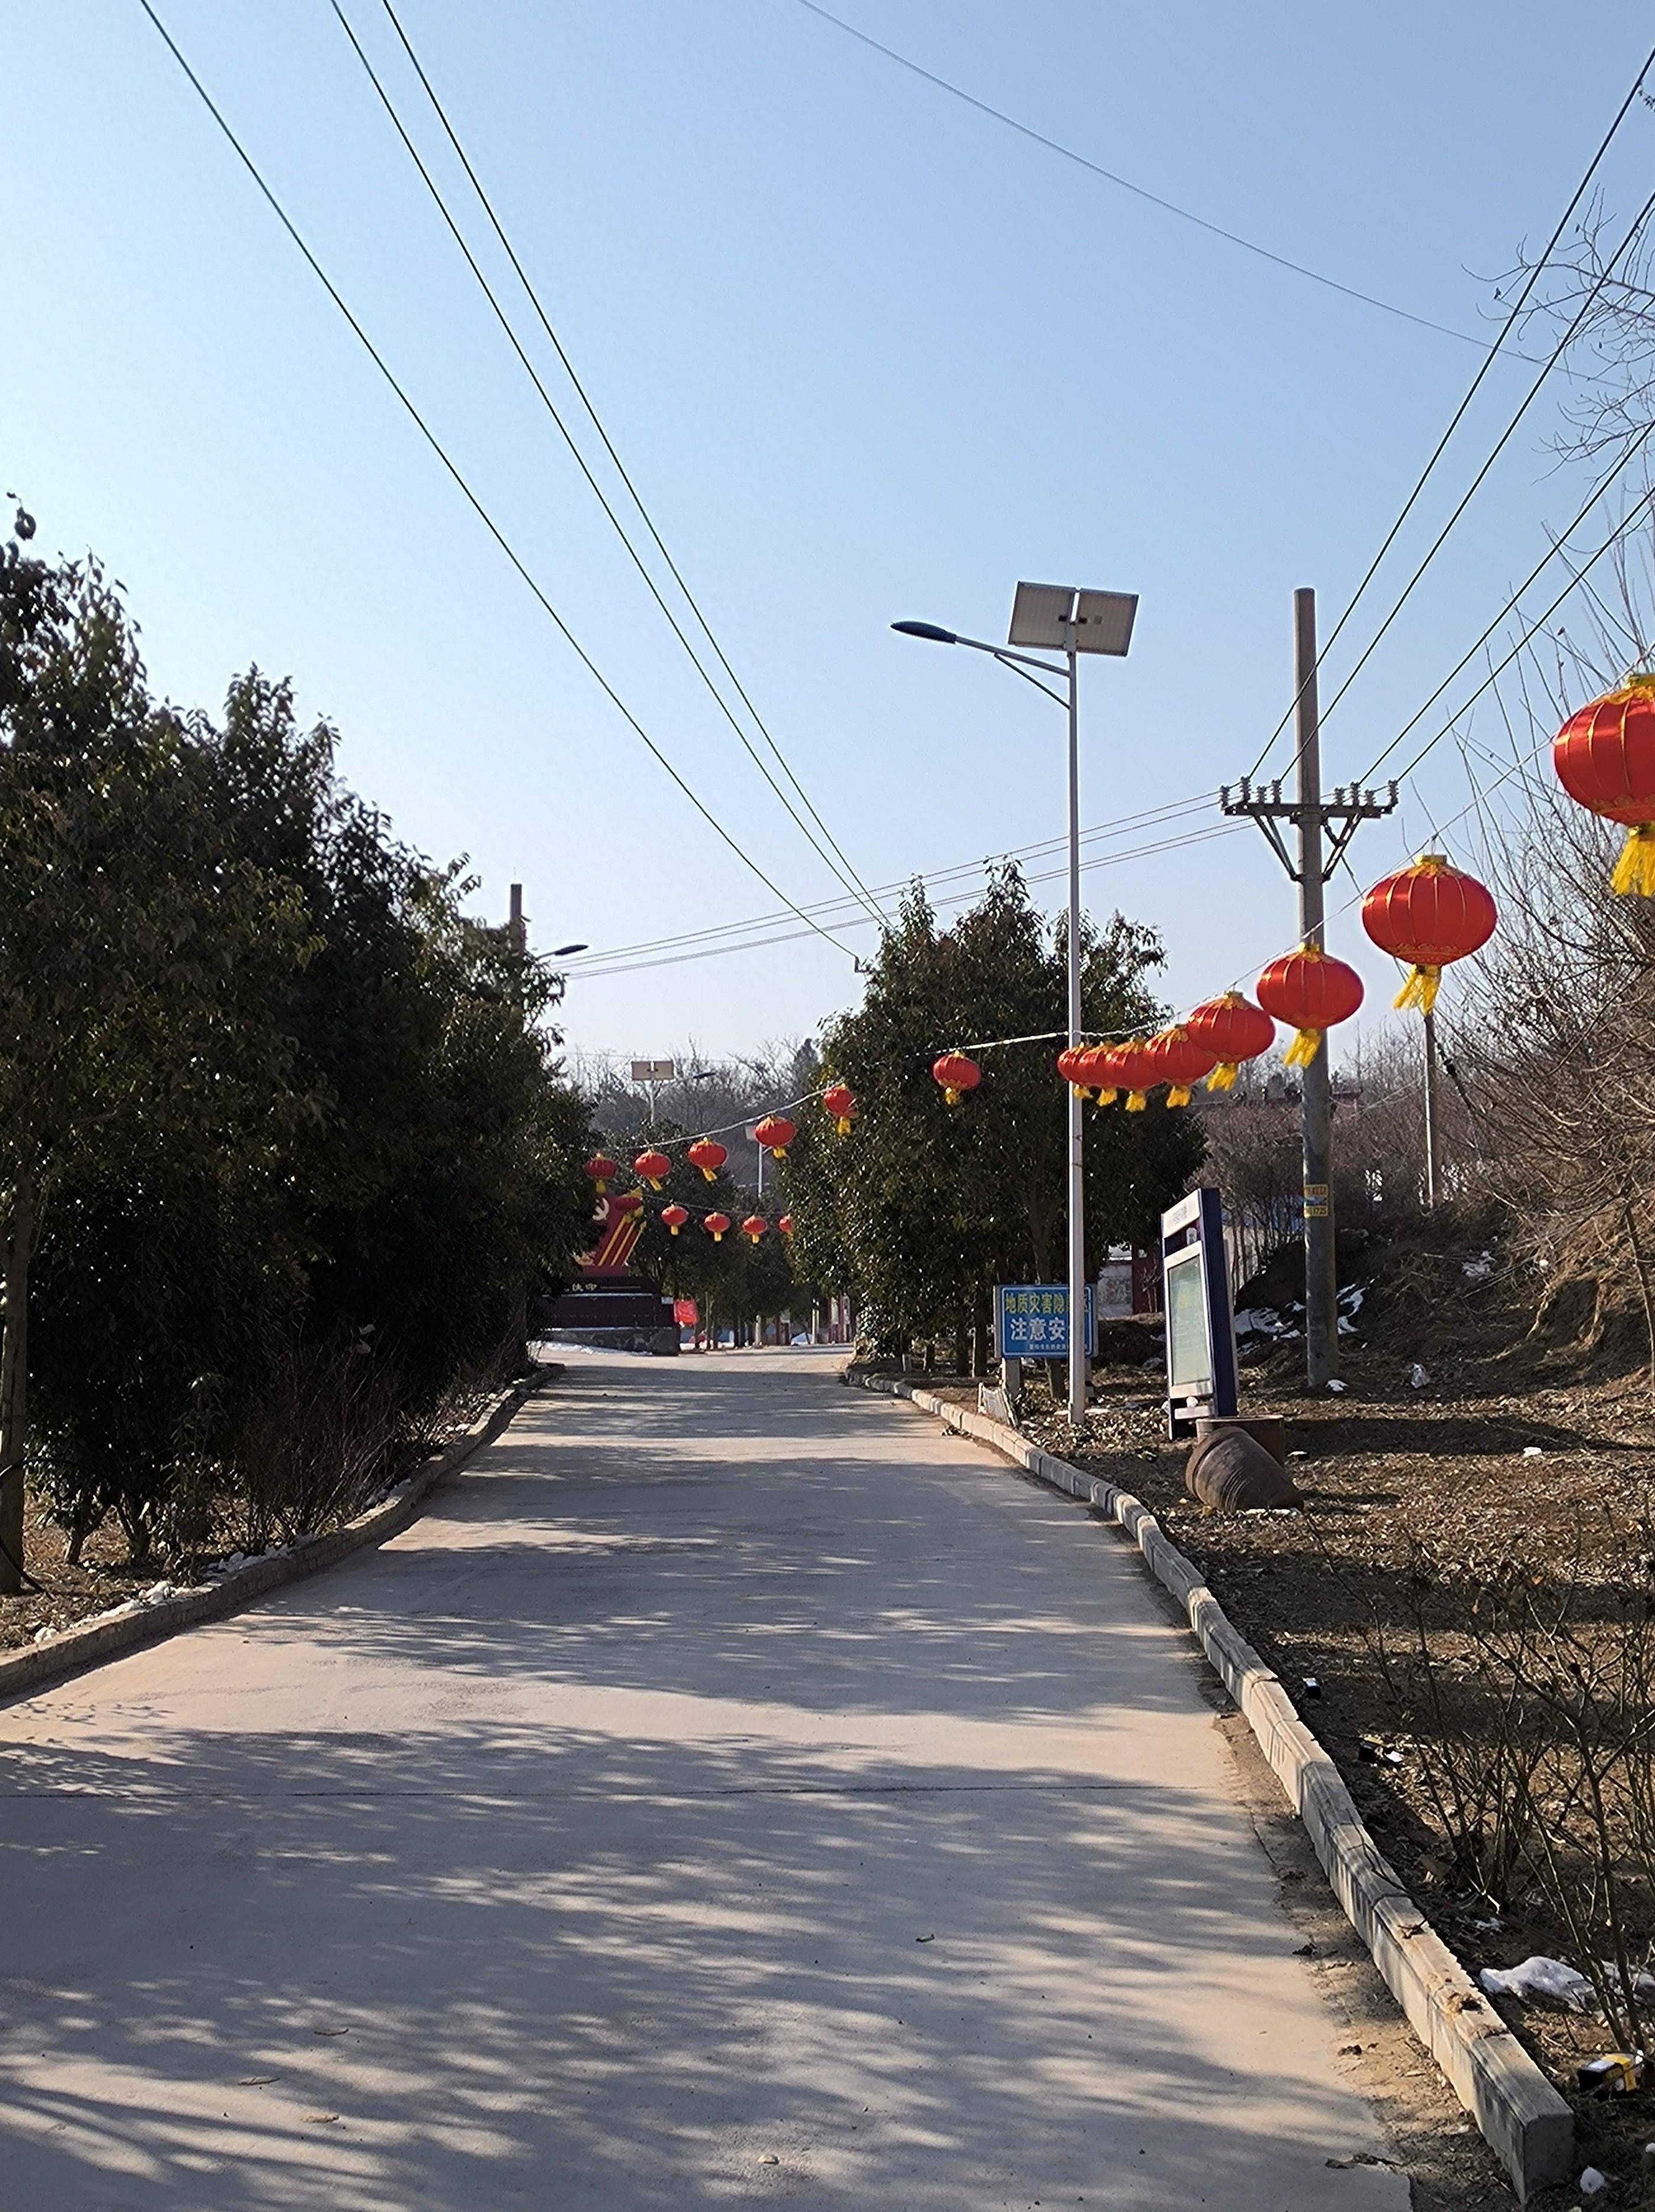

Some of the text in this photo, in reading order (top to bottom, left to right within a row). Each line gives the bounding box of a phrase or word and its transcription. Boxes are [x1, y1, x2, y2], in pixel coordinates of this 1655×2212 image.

[1005, 1292, 1089, 1314] 地质灾害隐
[1010, 1317, 1069, 1341] 注意安
